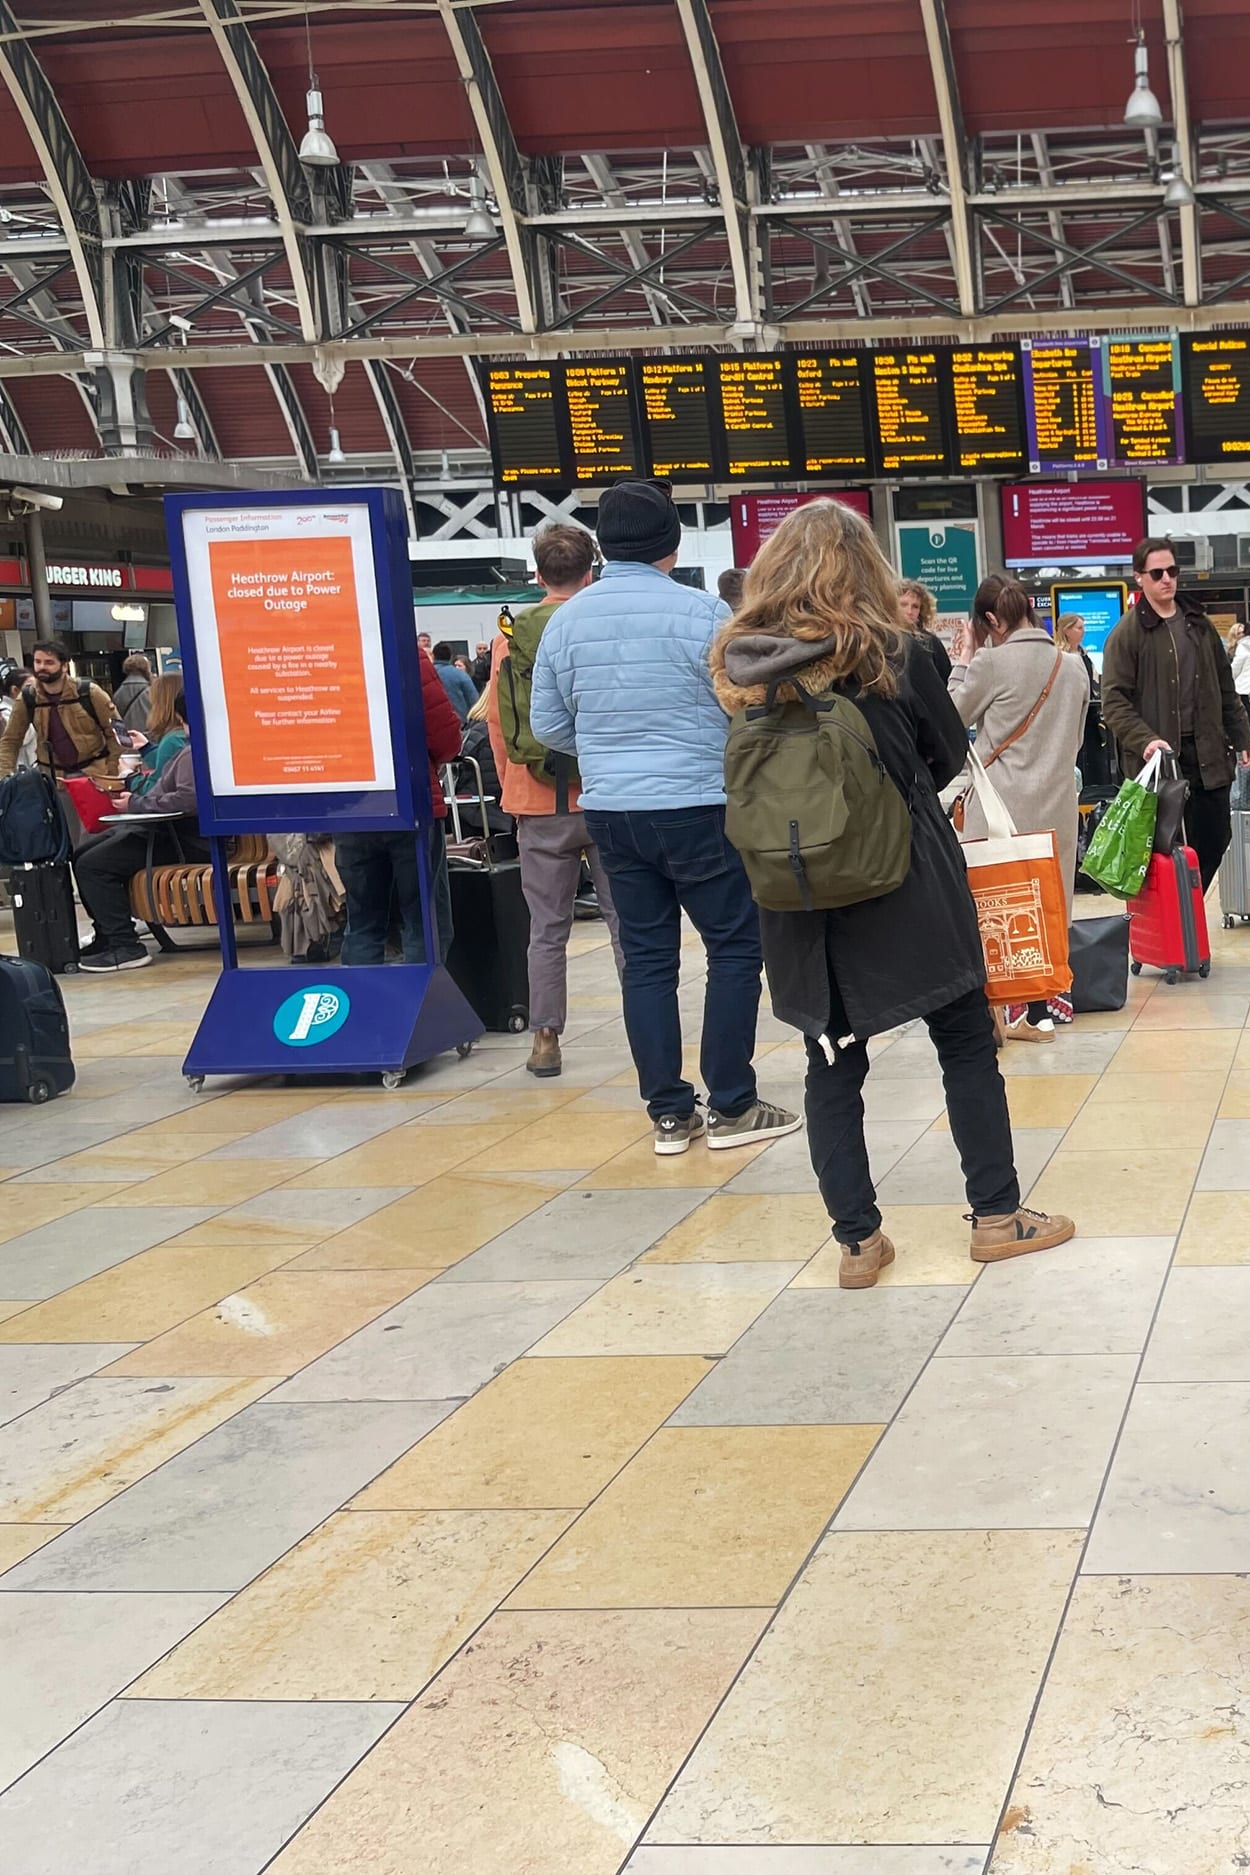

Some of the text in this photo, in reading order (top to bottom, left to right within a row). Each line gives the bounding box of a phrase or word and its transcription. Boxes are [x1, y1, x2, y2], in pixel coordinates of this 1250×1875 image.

[1138, 342, 1172, 352] Cancelled
[1192, 341, 1217, 352] Special
[978, 352, 1014, 361] Preparing
[1031, 349, 1063, 358] Elizabeth
[1110, 353, 1172, 364] Heathrow Airport
[743, 362, 773, 370] Platform
[953, 364, 992, 373] Cheltenham
[1031, 360, 1072, 368] Departures
[587, 368, 616, 376] Platform
[643, 366, 662, 374] 10:12
[663, 365, 693, 373] Platform
[797, 370, 822, 378] Oxford
[515, 370, 550, 379] Preparing
[720, 372, 774, 382] Cardiff Central
[566, 379, 619, 387] Didcot Parkway
[643, 376, 673, 384] Newbury
[490, 382, 523, 390] Penzance
[1141, 390, 1174, 400] Cancelled
[1113, 401, 1175, 411] Heathrow Airport
[205, 514, 282, 523] Passenger Information
[231, 524, 269, 533] Paddington
[948, 557, 958, 565] QR
[947, 565, 958, 573] live
[46, 566, 122, 587] URGER KING
[231, 571, 335, 584] Heathrow Airport:
[227, 584, 341, 598] closed due to Power
[264, 599, 307, 612] Outage
[282, 646, 305, 654] Airport
[314, 661, 337, 669] nearby
[255, 710, 276, 718] Please
[304, 710, 318, 720] your
